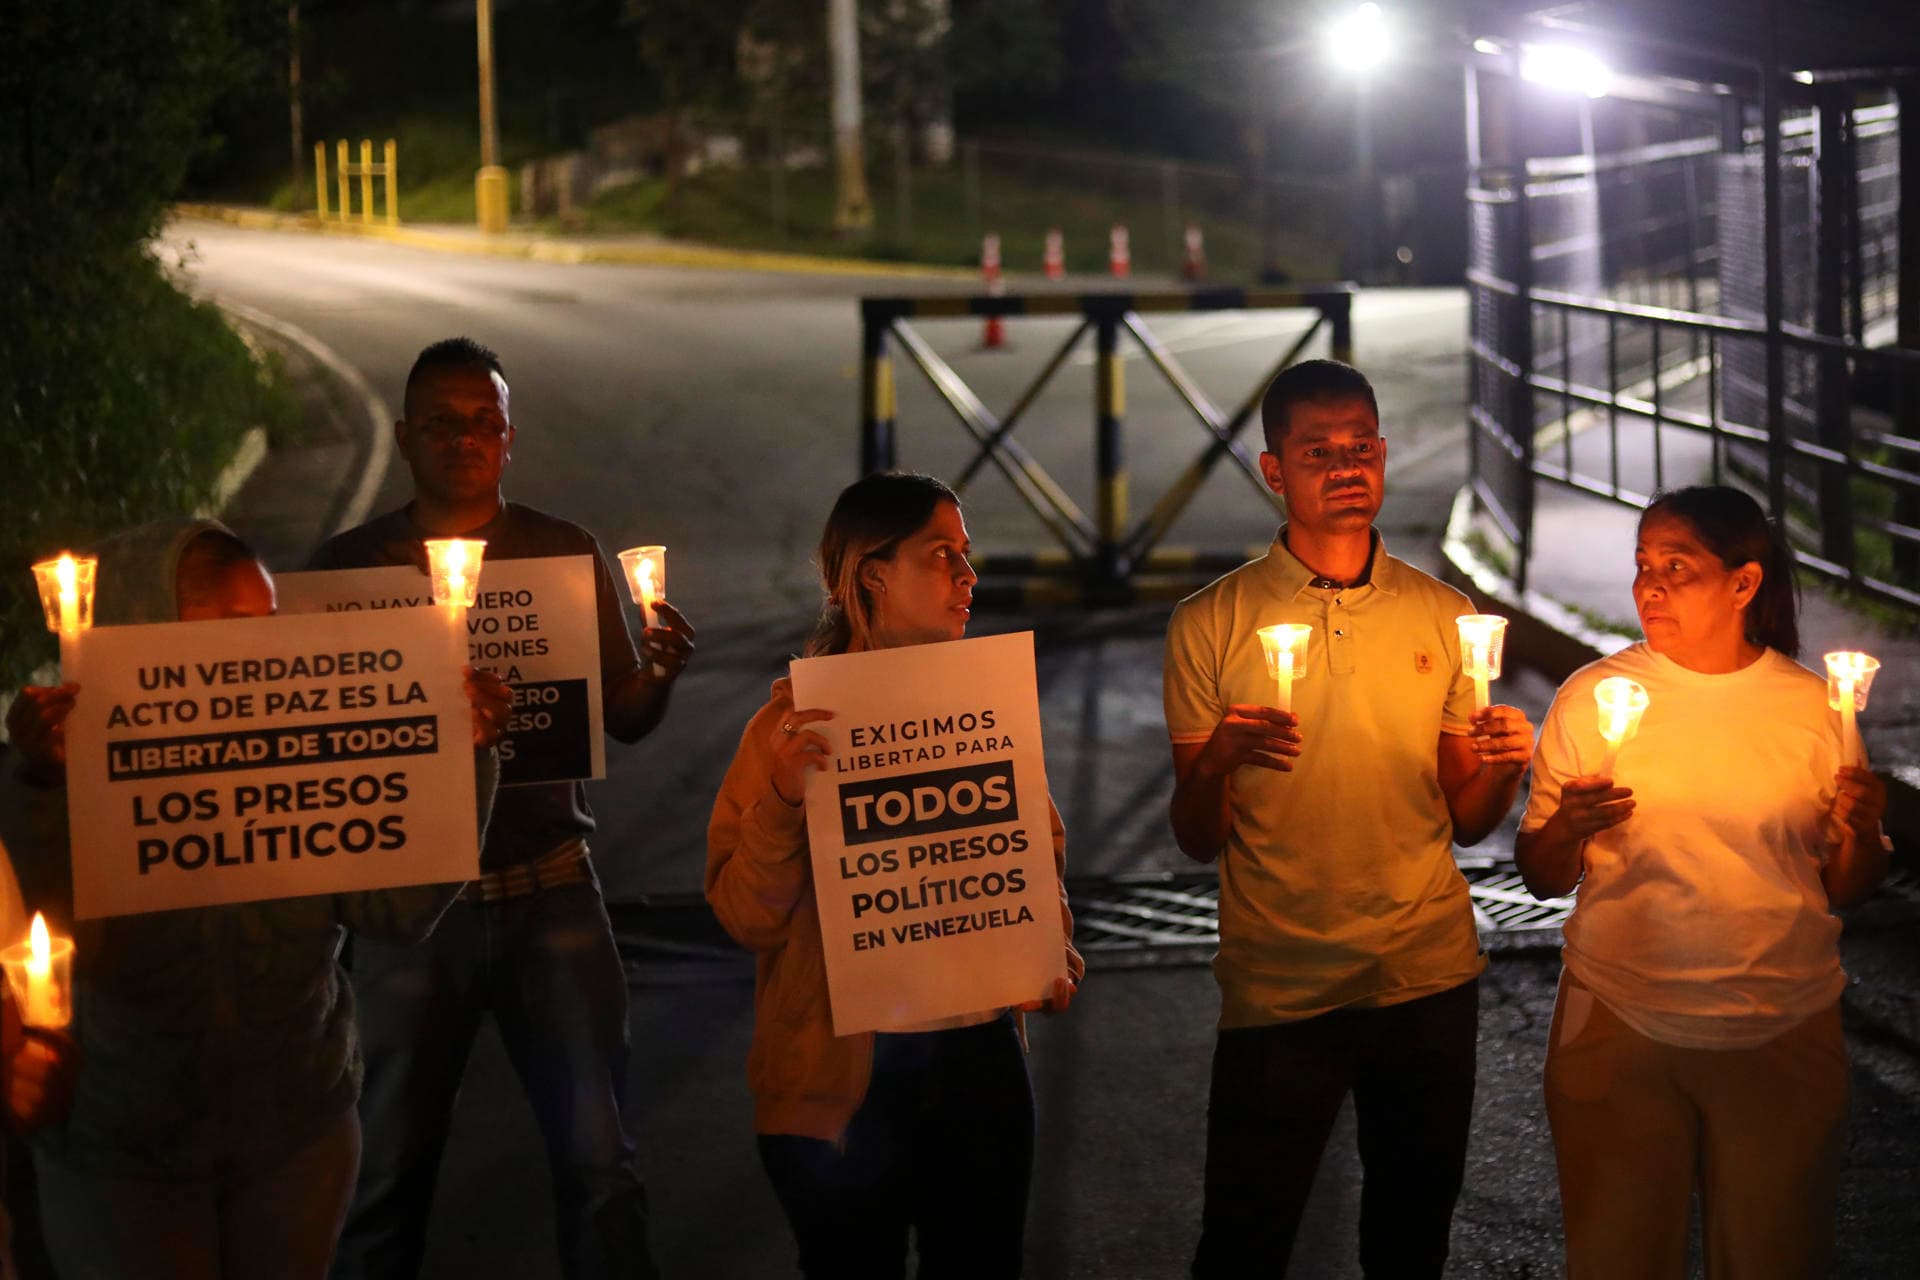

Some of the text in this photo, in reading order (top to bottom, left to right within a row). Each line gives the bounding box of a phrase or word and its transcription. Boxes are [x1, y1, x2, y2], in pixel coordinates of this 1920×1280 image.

[507, 614, 539, 632] DE
[138, 649, 403, 691] UN VERDADERO
[106, 681, 428, 730] ACTO DE PAZ ES LA
[850, 710, 996, 748] EXIGIMOS
[113, 724, 434, 772] LIBERTAD DE TODOS
[836, 735, 1014, 773] LIBERTAD PARA
[132, 771, 409, 828] LOS PRESOS
[845, 775, 1011, 831] TODOS
[137, 815, 407, 876] POLÍTICOS
[839, 829, 1029, 880] LOS PRESOS
[851, 868, 1027, 919] POLÍTICOS
[852, 905, 1035, 952] EN VENEZUELA
